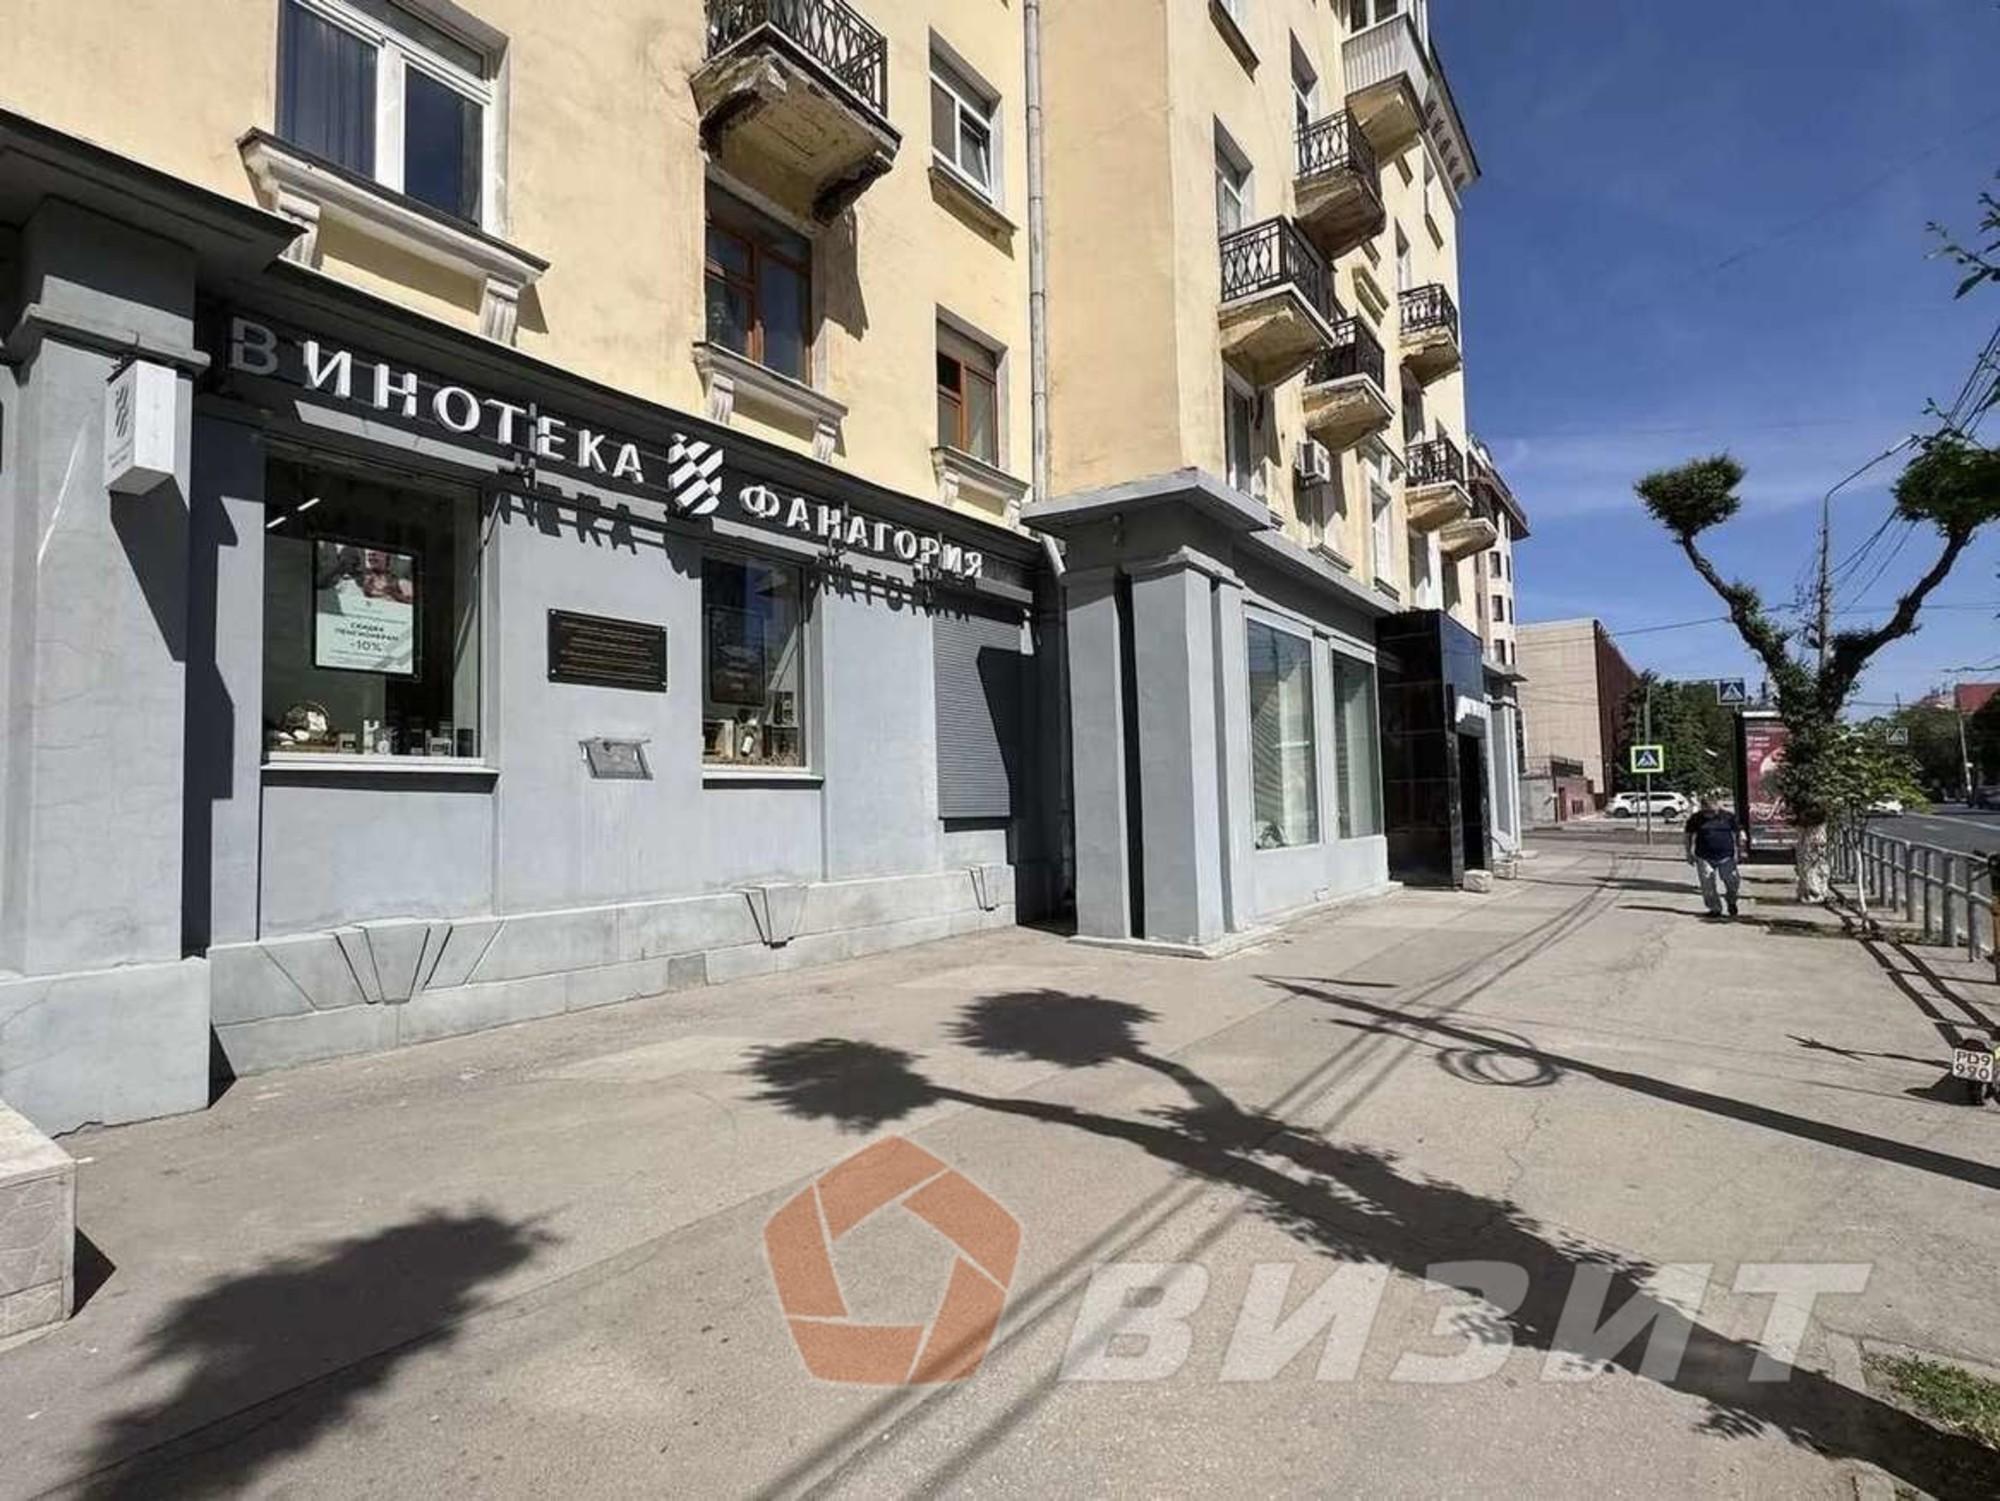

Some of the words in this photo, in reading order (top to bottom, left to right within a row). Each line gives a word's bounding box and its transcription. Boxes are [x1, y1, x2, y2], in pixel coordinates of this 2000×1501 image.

[229, 316, 645, 484] ВИНОТЕКА
[738, 484, 984, 578] ФАНАГОРИЯ
[349, 640, 383, 652] -10%
